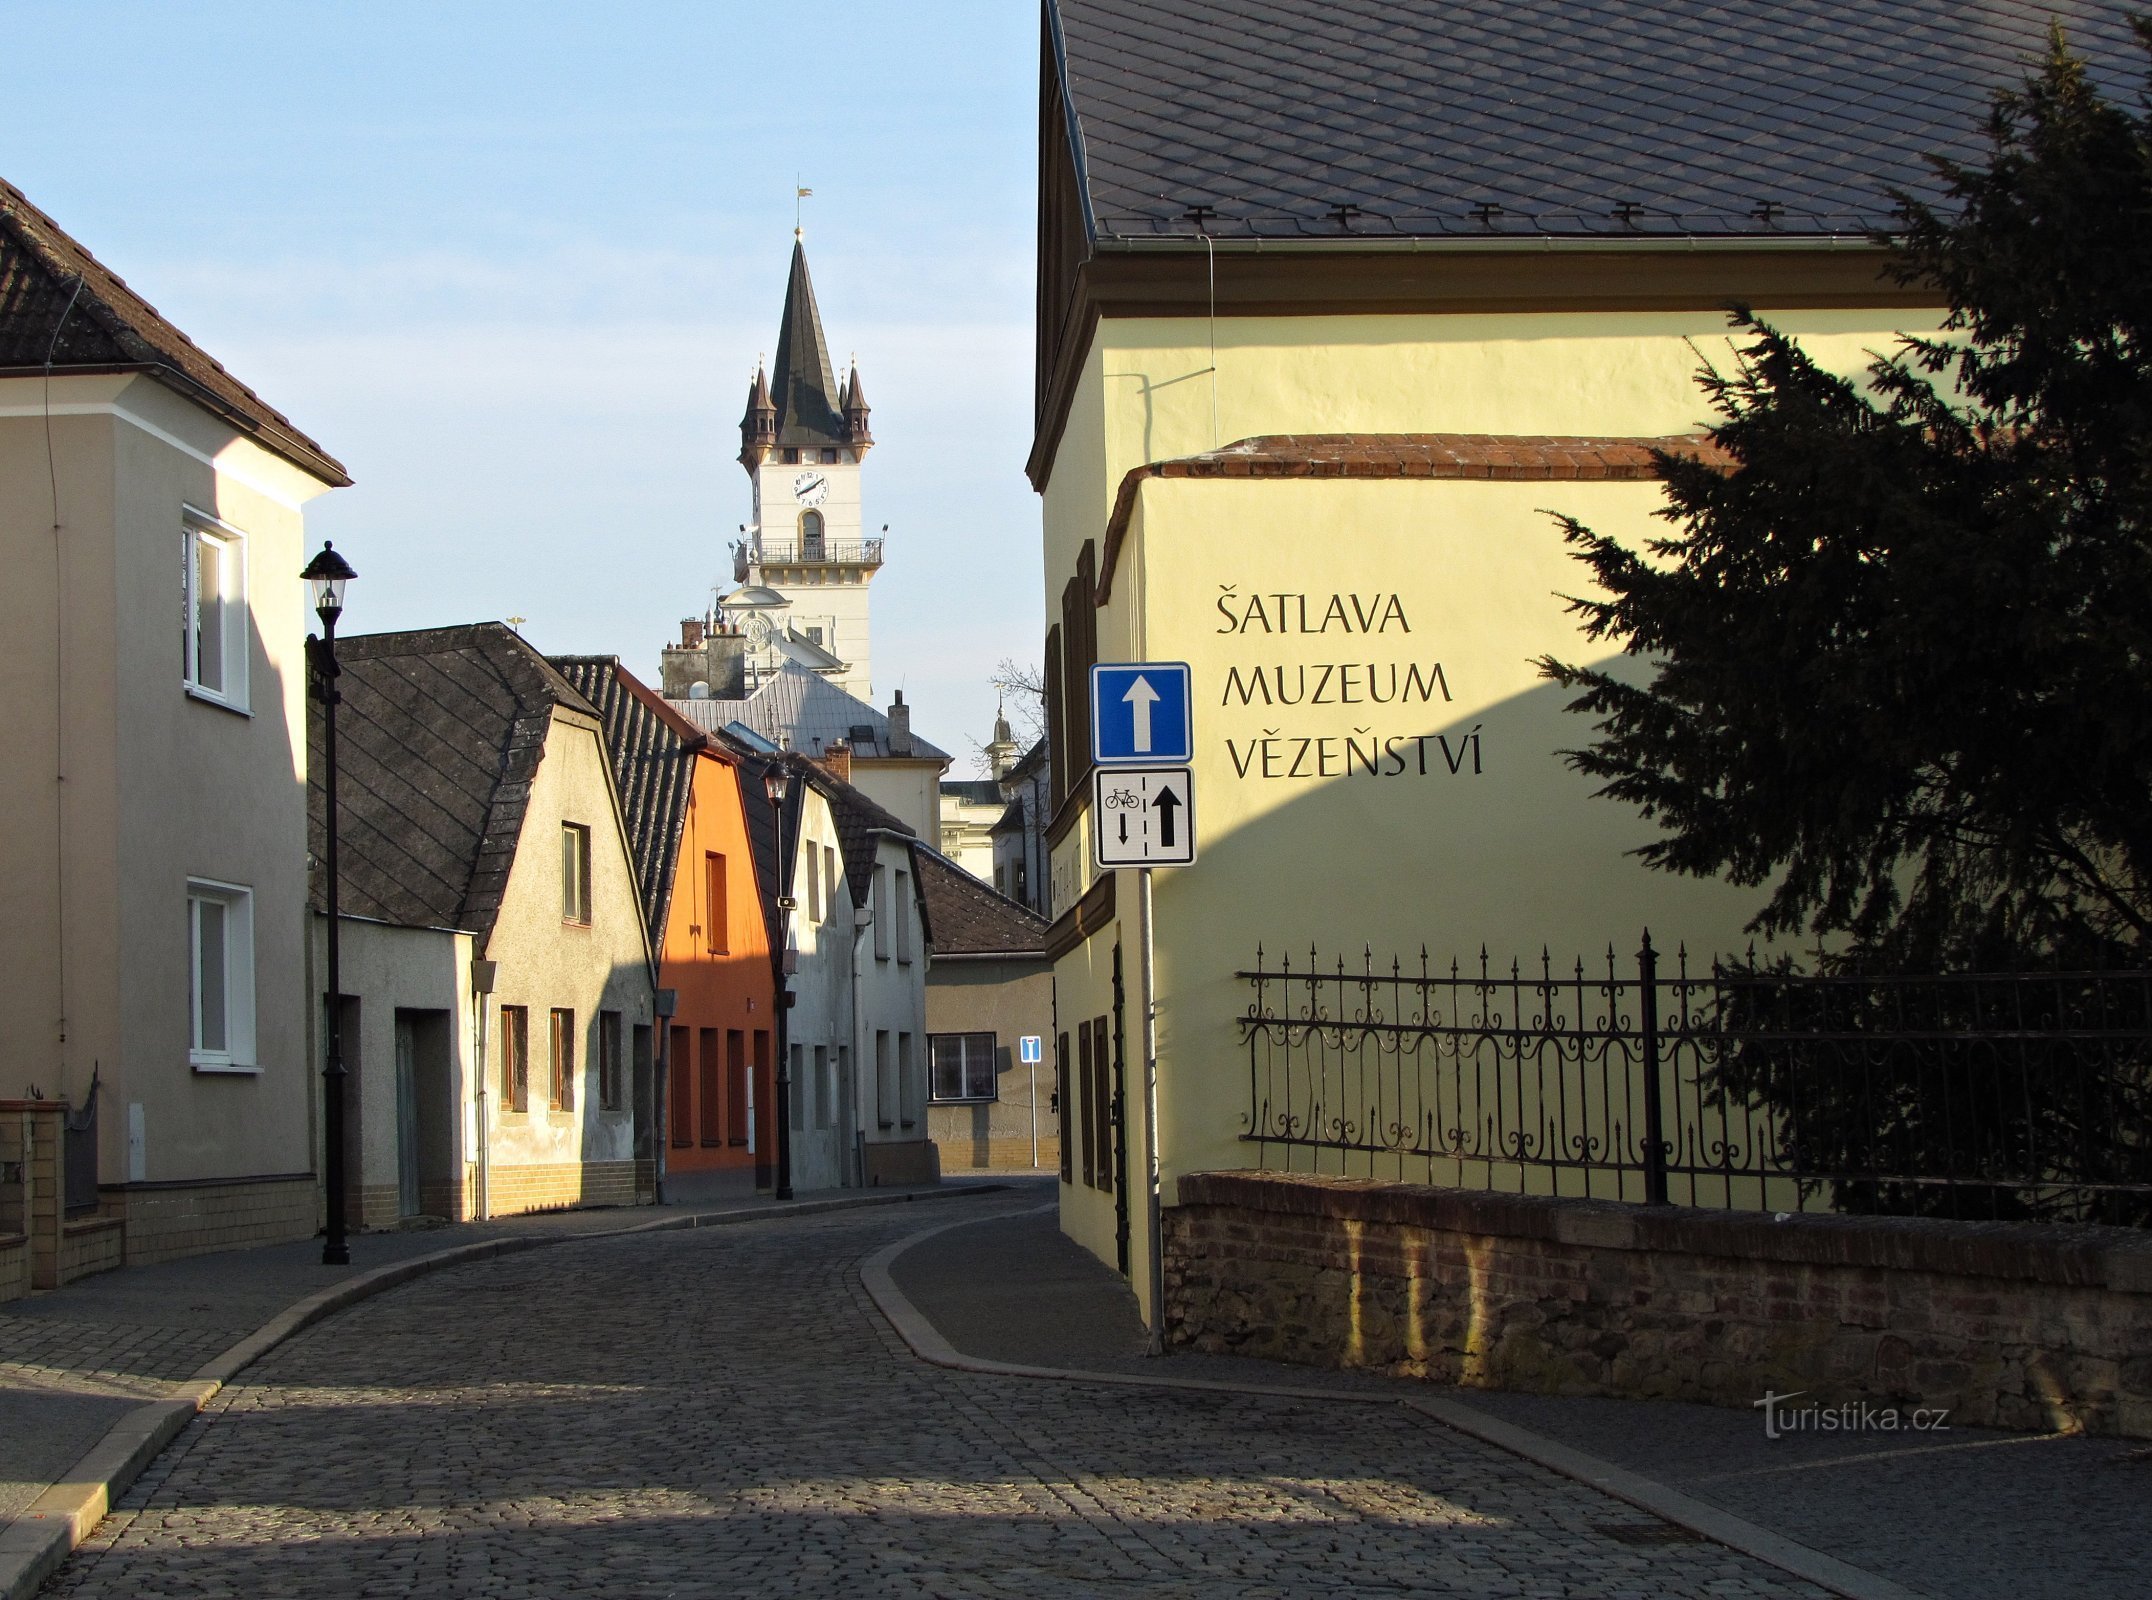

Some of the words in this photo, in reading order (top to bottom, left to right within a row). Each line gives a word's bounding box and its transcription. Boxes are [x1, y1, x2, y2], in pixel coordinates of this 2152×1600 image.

[1216, 584, 1411, 634] ŠATLAVA
[1221, 662, 1454, 707] MUZEUM
[1225, 724, 1483, 780] VĚZEŇSTVÍ
